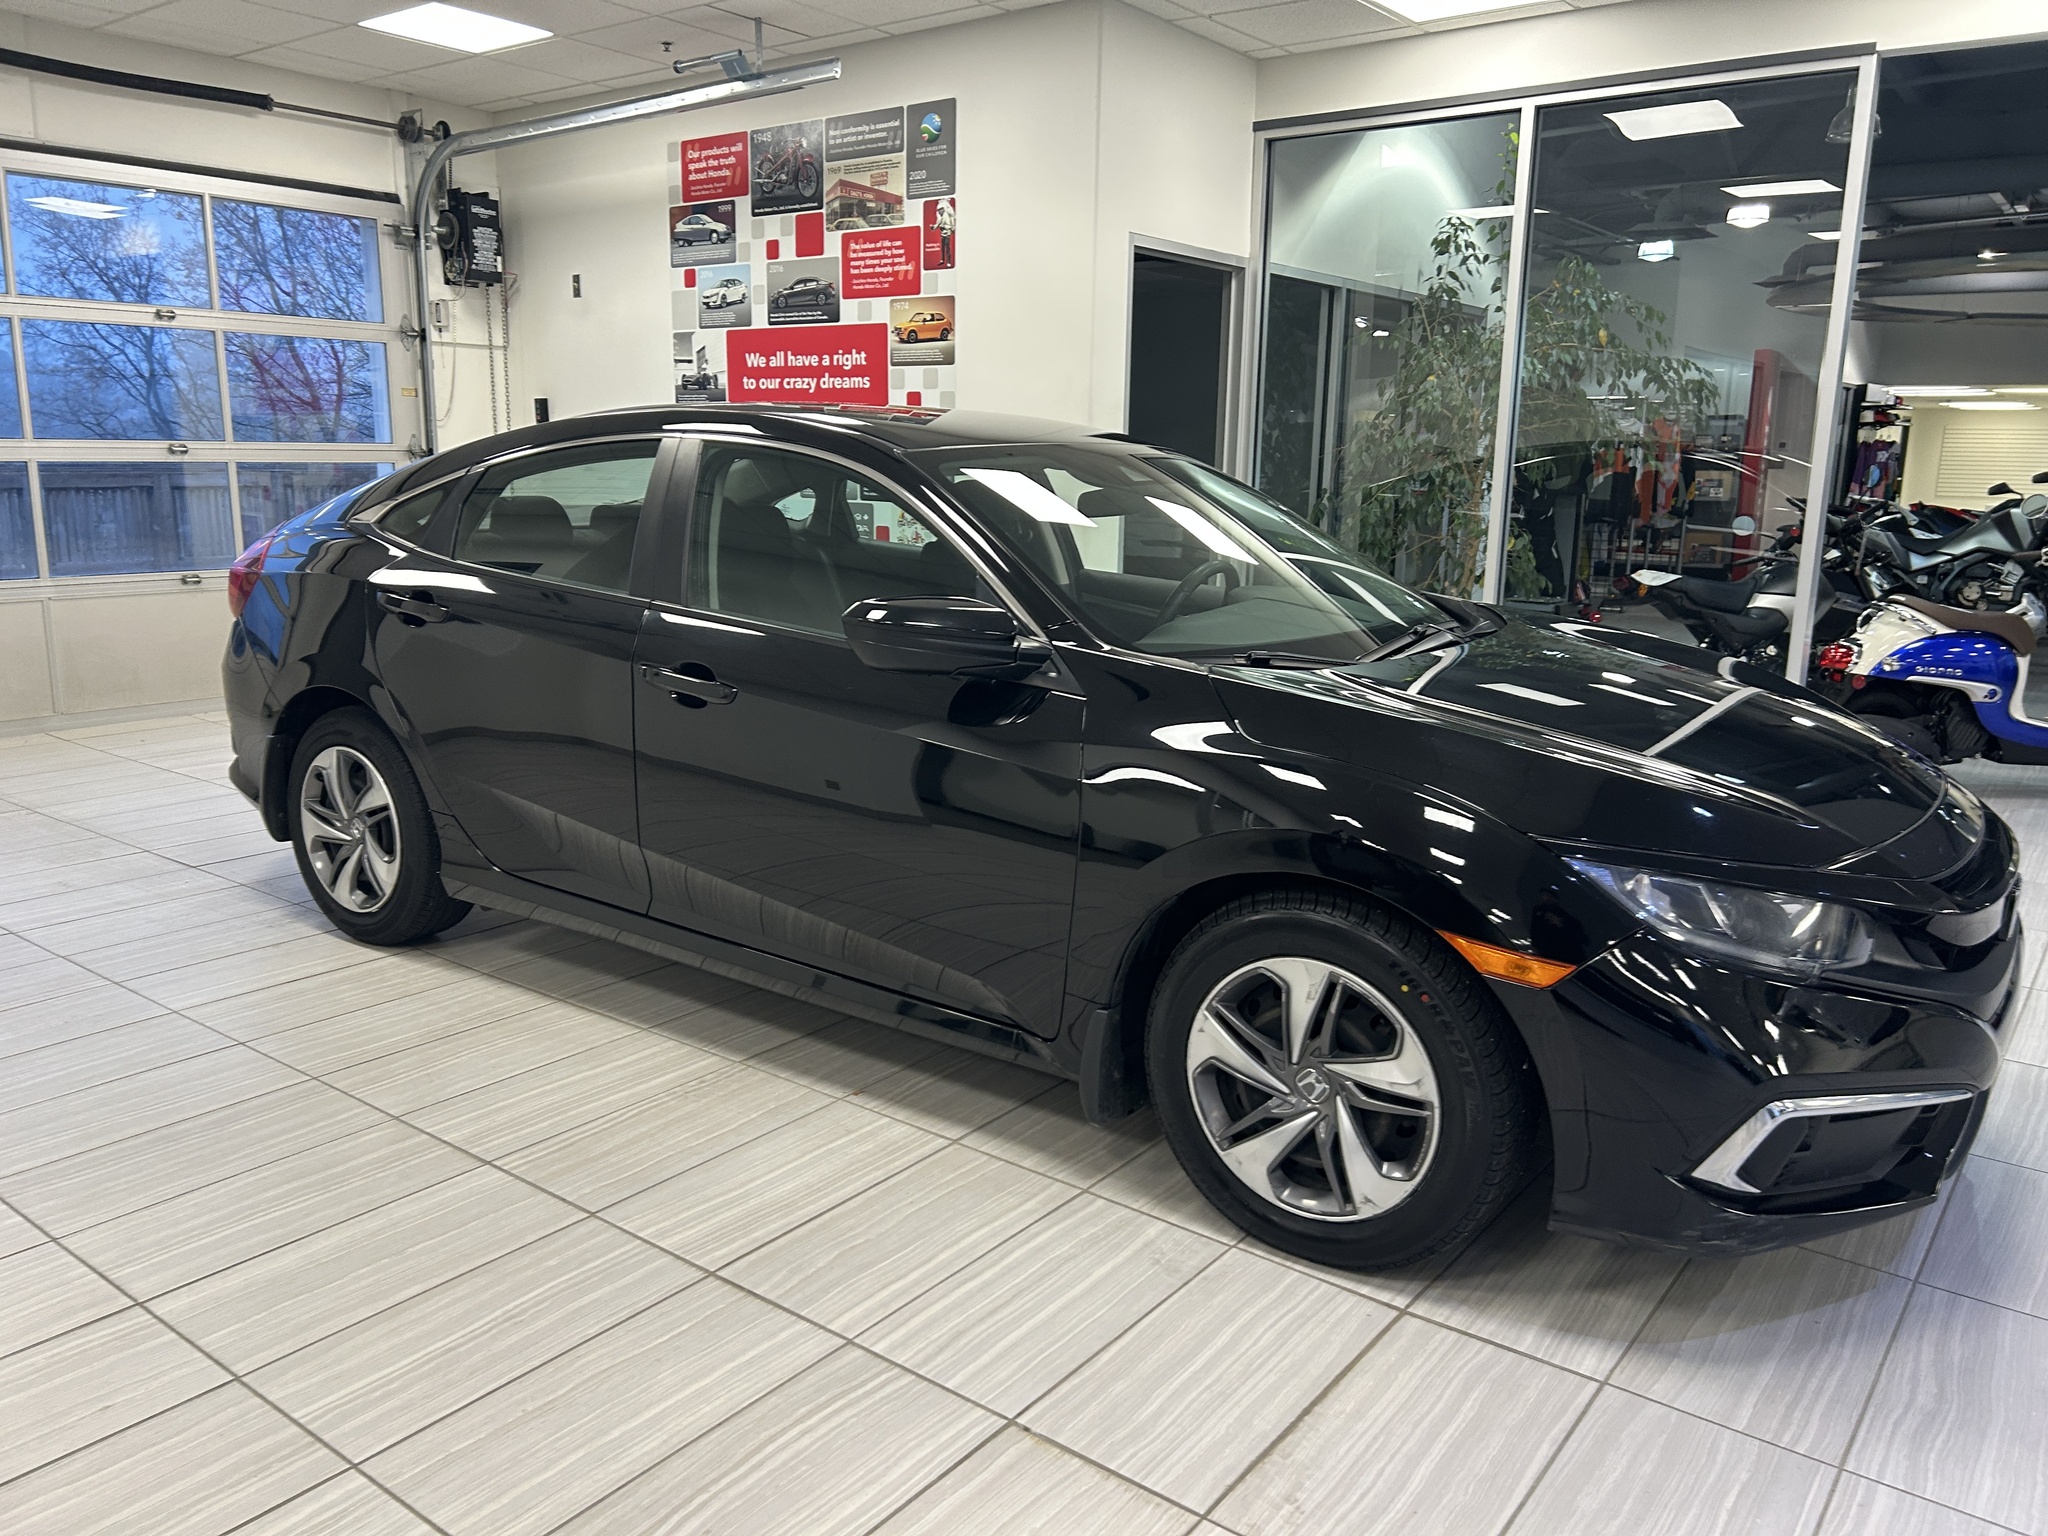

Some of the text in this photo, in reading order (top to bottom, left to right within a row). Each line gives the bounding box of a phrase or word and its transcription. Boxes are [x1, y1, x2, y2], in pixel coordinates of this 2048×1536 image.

[841, 124, 869, 134] conformity
[876, 119, 900, 129] essential
[753, 132, 772, 144] 1948
[688, 142, 743, 159] Our products will
[688, 155, 736, 171] speak the truth
[688, 168, 731, 180] about Honda.
[827, 166, 841, 175] 1969
[909, 170, 926, 180] 2020
[718, 204, 732, 213] 1999
[858, 249, 883, 257] measured
[769, 264, 784, 273] 2016
[874, 265, 892, 273] deeply
[893, 263, 913, 271] stirred.
[700, 270, 714, 278] 2016
[892, 302, 910, 311] 1974
[745, 349, 866, 370] We all have a right
[743, 372, 870, 393] to our crazy dreams
